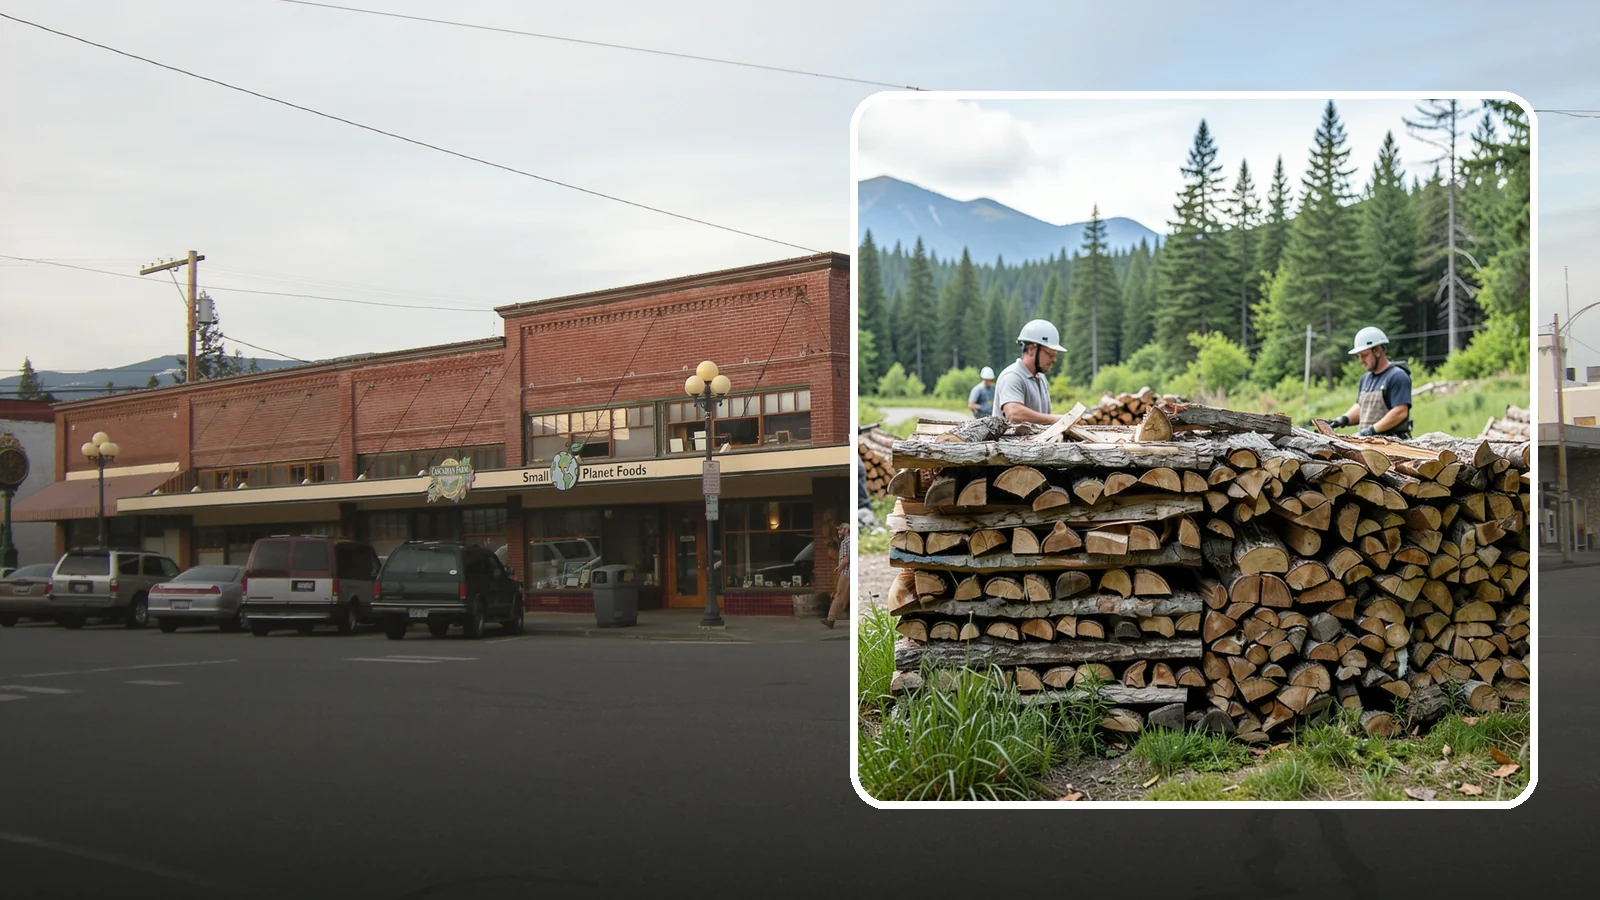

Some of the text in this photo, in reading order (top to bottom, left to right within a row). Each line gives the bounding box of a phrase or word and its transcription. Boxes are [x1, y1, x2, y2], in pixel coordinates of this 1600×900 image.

[523, 464, 647, 482] Small Planet Foods
